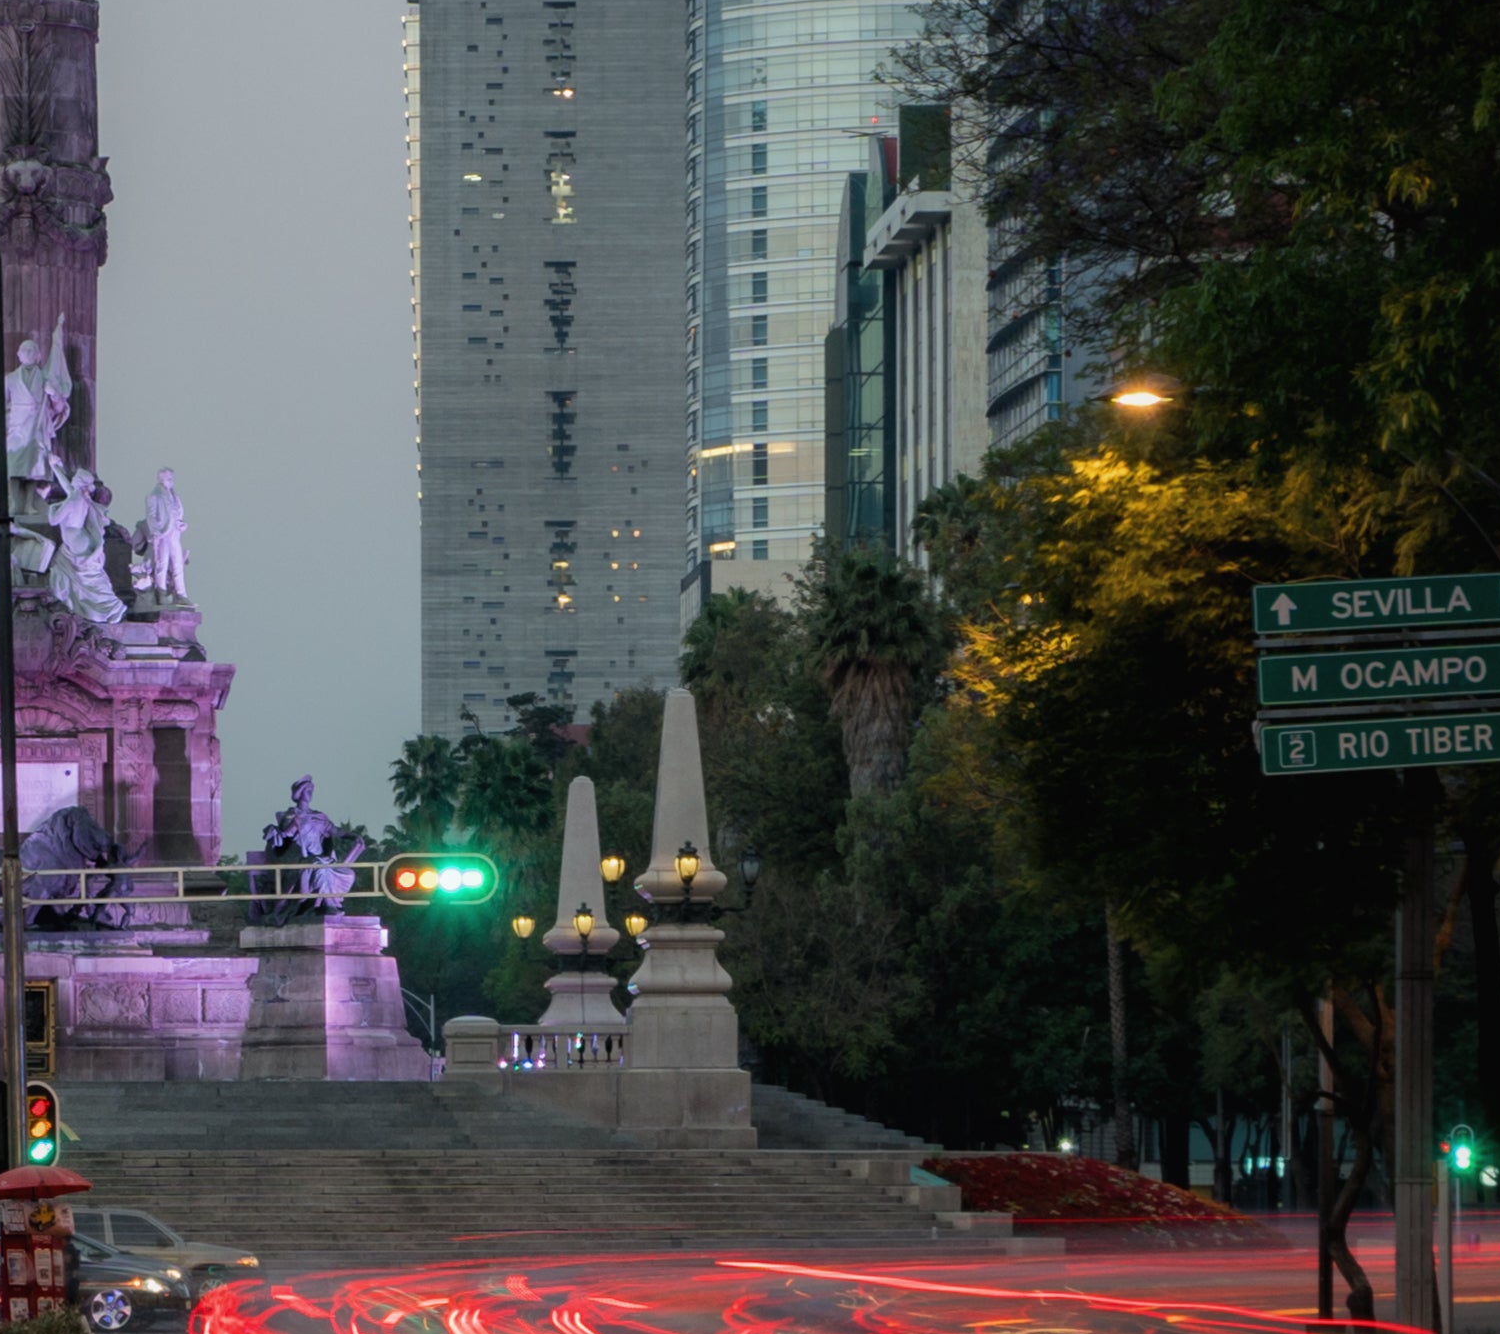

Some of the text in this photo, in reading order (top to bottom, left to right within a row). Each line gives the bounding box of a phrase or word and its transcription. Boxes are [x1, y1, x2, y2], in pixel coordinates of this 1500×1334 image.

[1331, 585, 1472, 620] SEVILLA
[1291, 655, 1487, 693] M OCAMPO
[1288, 723, 1494, 760] 2 RIO TIBER
